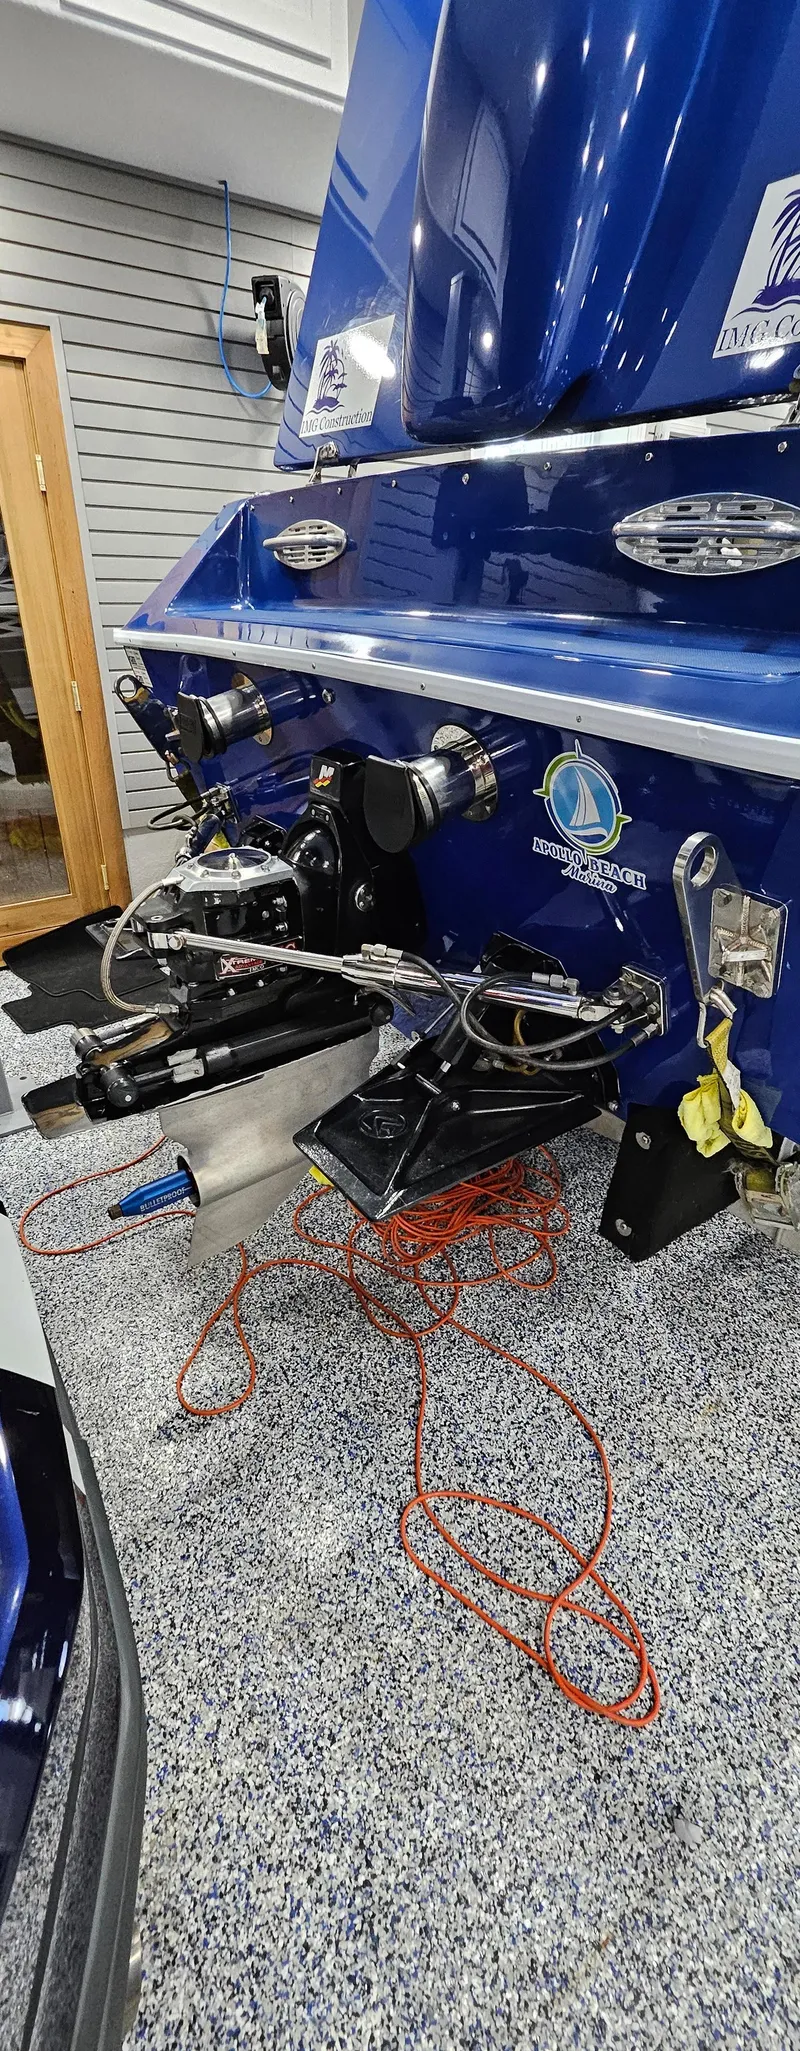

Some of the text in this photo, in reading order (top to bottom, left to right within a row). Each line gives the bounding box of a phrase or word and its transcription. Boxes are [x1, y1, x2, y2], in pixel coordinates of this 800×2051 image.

[716, 320, 770, 352] IMG
[300, 408, 373, 434] IMG Construction
[533, 837, 647, 890] APOLLO BEACH
[561, 863, 617, 893] Marina
[140, 1186, 187, 1212] BULLETPROOF
